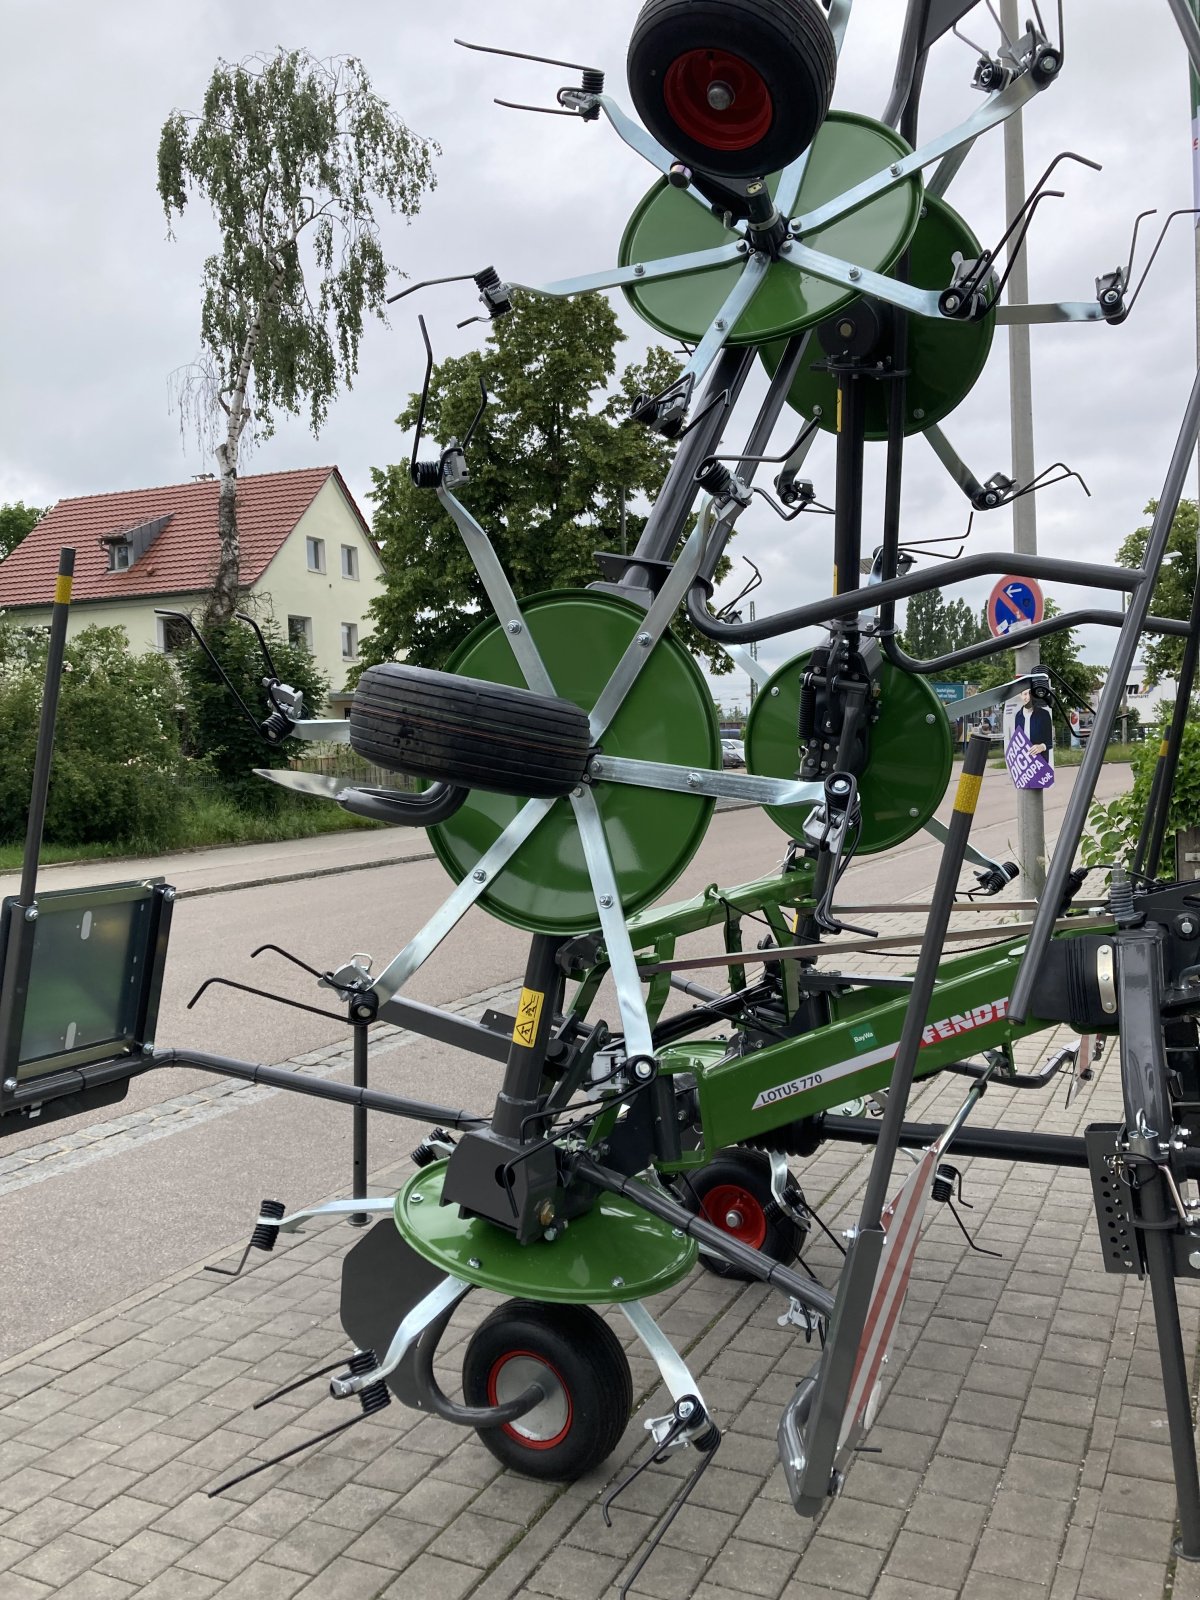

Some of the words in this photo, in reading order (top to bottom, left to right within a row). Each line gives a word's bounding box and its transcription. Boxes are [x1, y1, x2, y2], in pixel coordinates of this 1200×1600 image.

[1007, 731, 1026, 766] TRAU
[1011, 744, 1037, 783] DICH
[1038, 771, 1053, 786] Volt
[922, 996, 1009, 1044] FENDT
[853, 1031, 874, 1043] BayWa
[760, 1082, 799, 1104] LOTUS
[799, 1074, 823, 1089] 770
